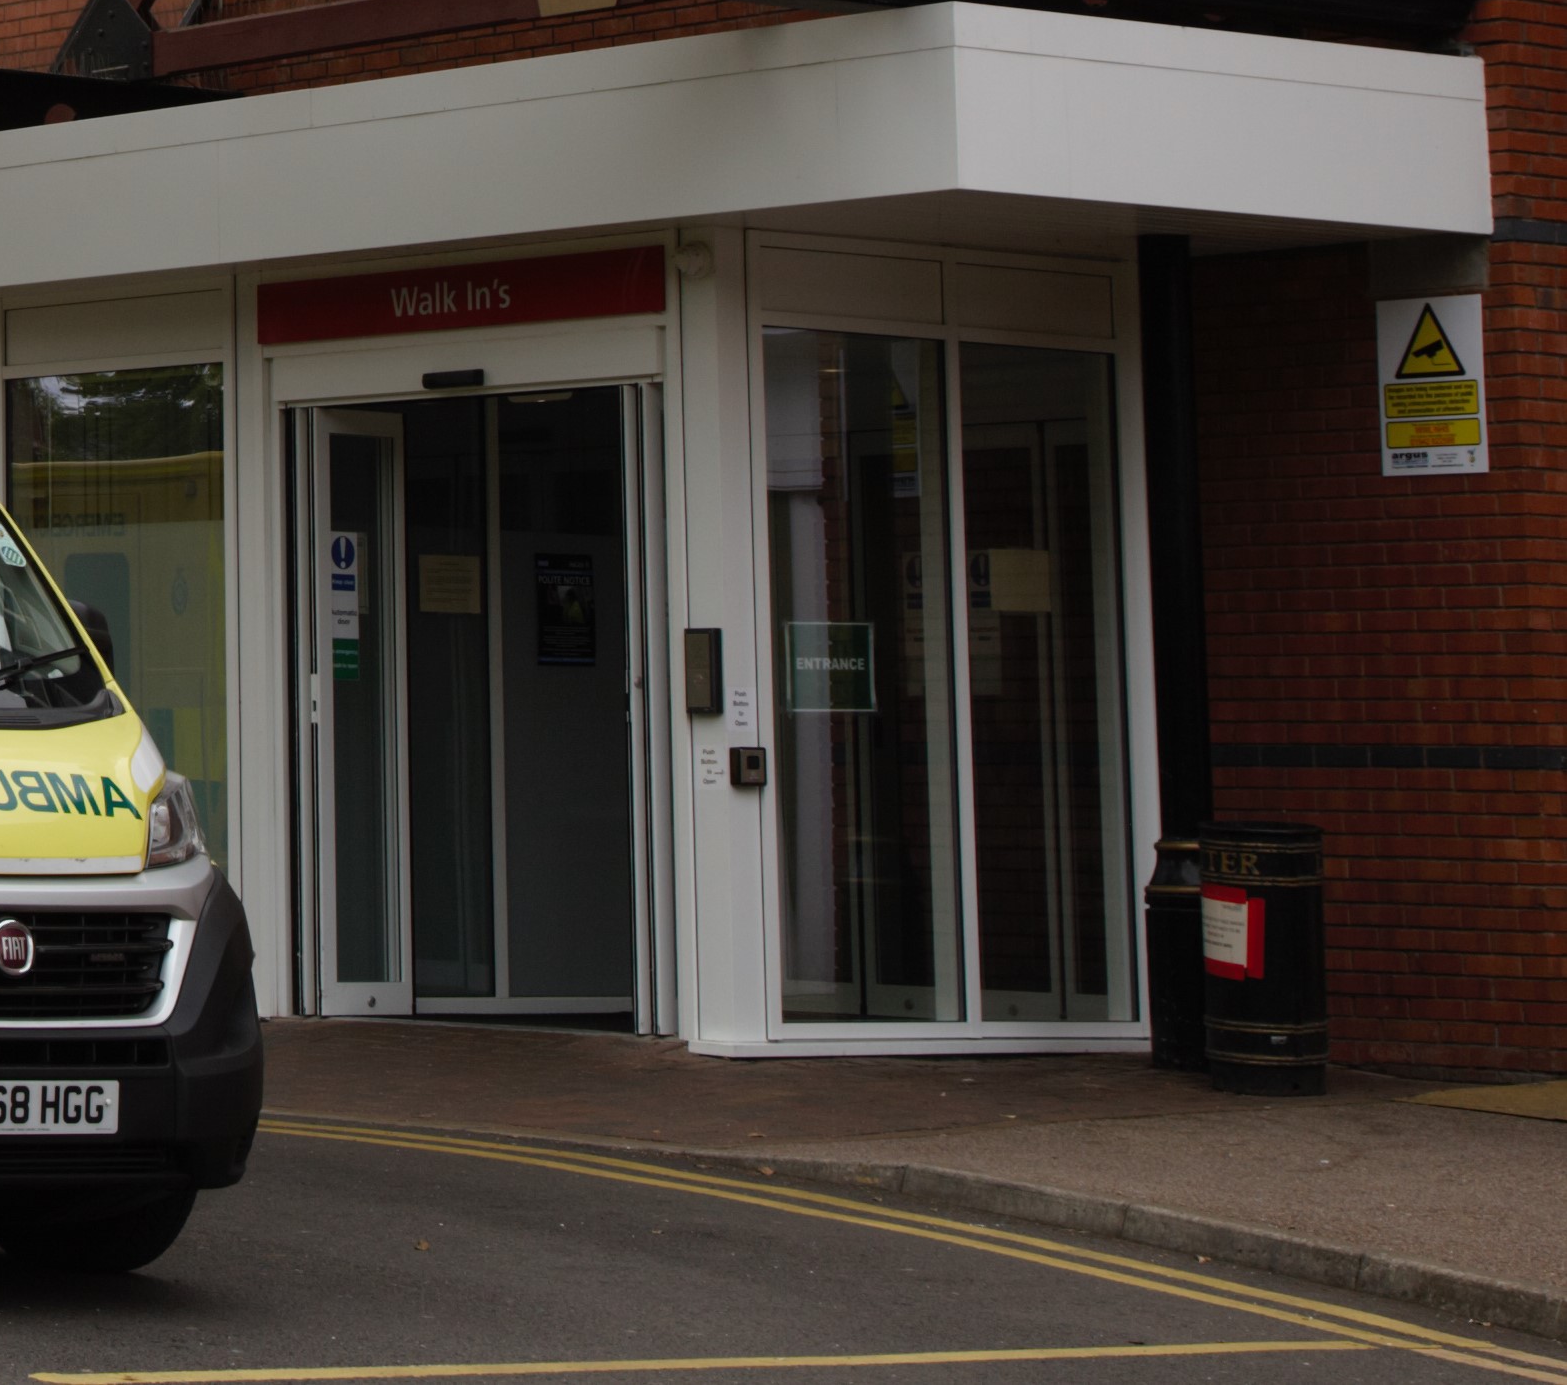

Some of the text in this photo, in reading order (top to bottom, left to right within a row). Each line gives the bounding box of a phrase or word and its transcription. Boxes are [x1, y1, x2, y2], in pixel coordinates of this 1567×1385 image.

[390, 278, 512, 318] Walk In's
[1392, 452, 1428, 460] argus
[538, 574, 591, 585] POLITE NOTICE
[795, 657, 866, 671] ENTRANCE
[1, 936, 26, 961] FIAT
[41, 1085, 104, 1124] HGG
